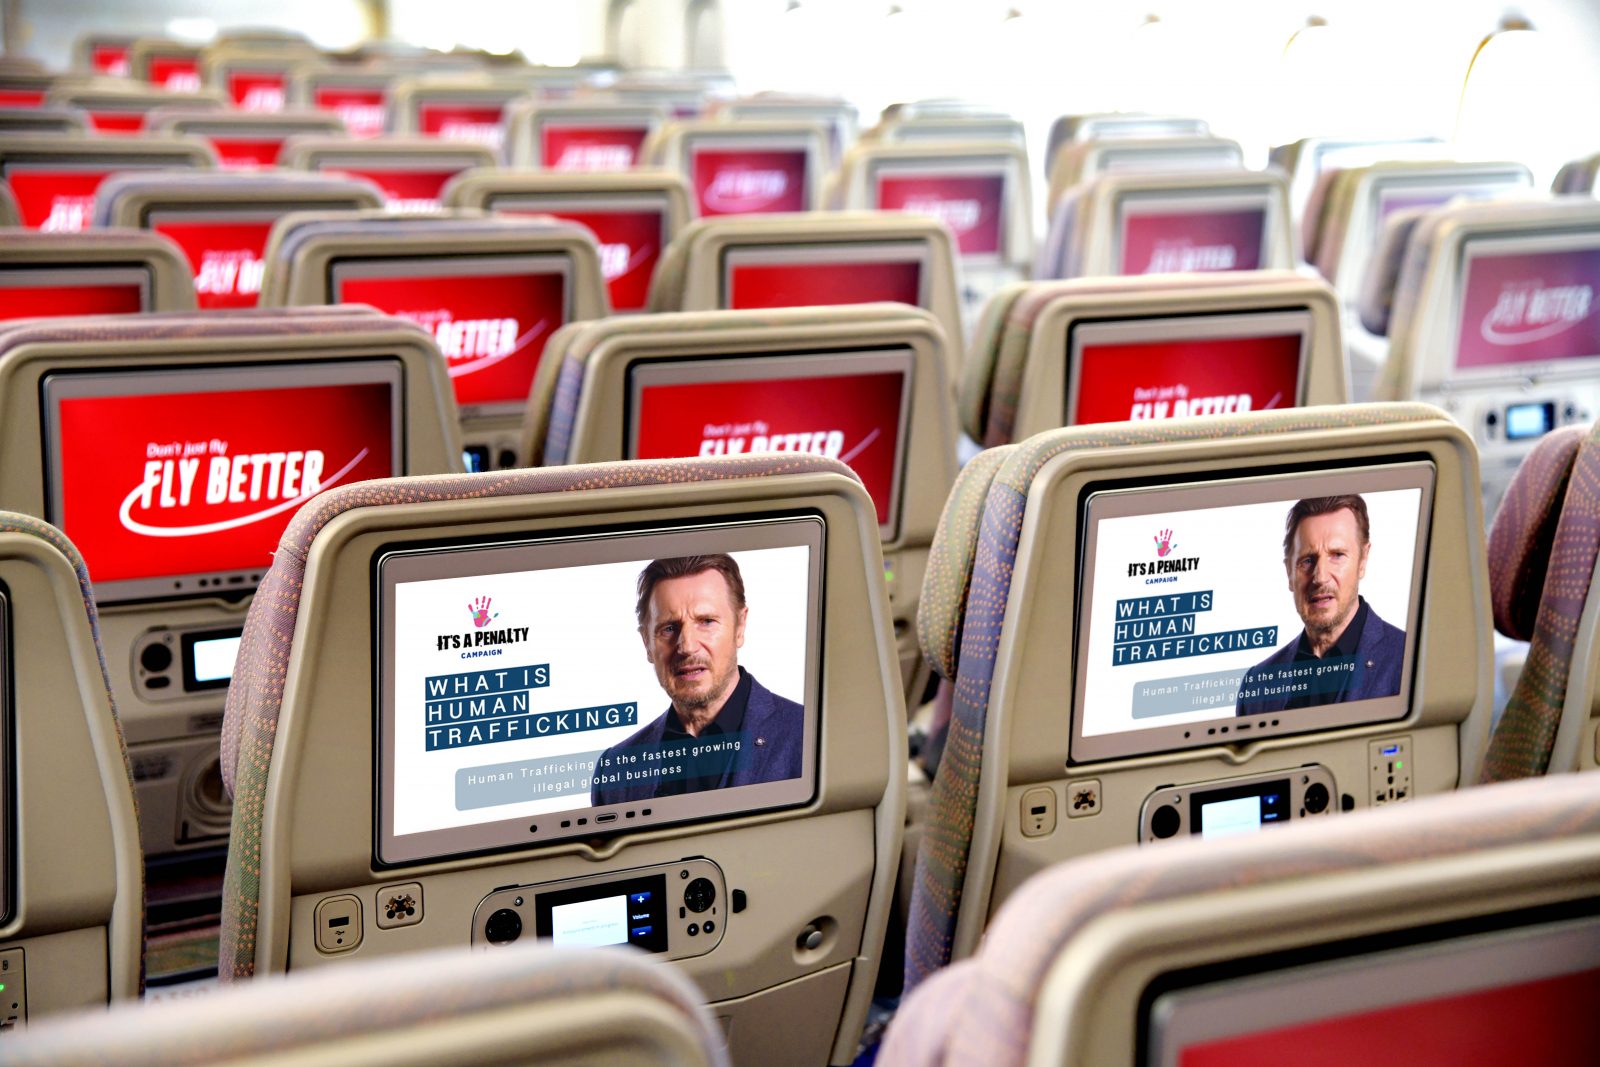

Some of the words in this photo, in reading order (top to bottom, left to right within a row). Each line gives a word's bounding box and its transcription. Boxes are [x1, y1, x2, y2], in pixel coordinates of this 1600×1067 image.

[146, 442, 182, 458] Don't
[182, 440, 208, 459] just
[208, 438, 228, 456] fly
[140, 458, 199, 509] FLY
[206, 450, 324, 505] BETTER
[1127, 562, 1146, 577] IT'S
[1150, 561, 1156, 575] A
[1157, 557, 1200, 574] PENALTY
[1145, 576, 1178, 585] CAMPAIGN
[1119, 597, 1180, 617] WHAT
[1192, 594, 1210, 610] IS
[436, 634, 461, 651] IT'S
[463, 633, 473, 648] A
[475, 627, 529, 647] PENALTY
[1116, 617, 1193, 641] HUMAN
[461, 649, 502, 659] CAMPAIGN
[1116, 629, 1275, 662] TRAFFICKING?
[429, 672, 508, 697] WHAT
[524, 667, 547, 686] IS
[1142, 685, 1178, 697] Human
[1183, 676, 1241, 692] Trafficking
[1245, 674, 1253, 683] is
[1258, 672, 1274, 682] the
[1278, 667, 1312, 679] fastest
[1316, 661, 1355, 676] growing
[1192, 693, 1225, 705] illegal
[1228, 688, 1260, 702] global
[1264, 682, 1308, 695] business
[428, 694, 527, 722] HUMAN
[429, 705, 635, 747] TRAFFICKING?
[468, 770, 513, 785] Human
[520, 760, 594, 778] Trafficking
[600, 757, 611, 767] is
[616, 754, 637, 765] the
[642, 748, 687, 761] fastest
[692, 740, 741, 757] growing
[533, 779, 575, 793] illegal
[581, 772, 620, 789] global
[626, 764, 682, 780] business
